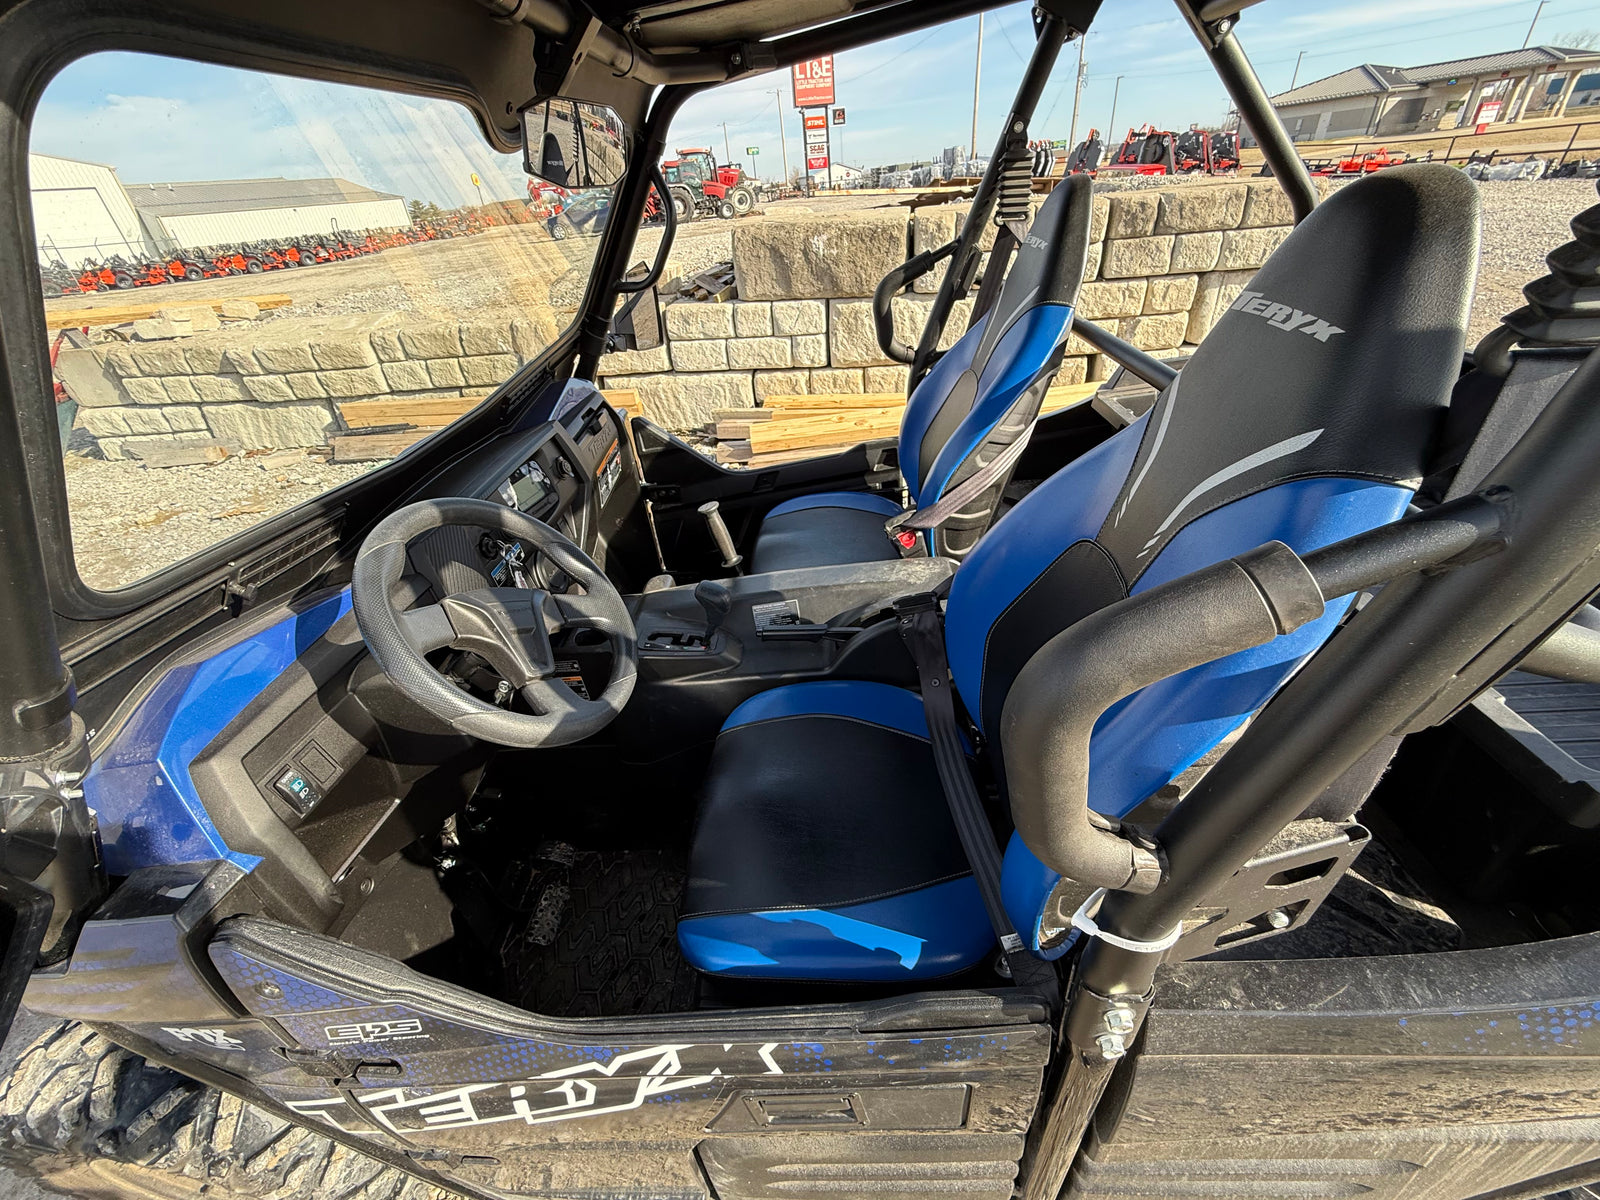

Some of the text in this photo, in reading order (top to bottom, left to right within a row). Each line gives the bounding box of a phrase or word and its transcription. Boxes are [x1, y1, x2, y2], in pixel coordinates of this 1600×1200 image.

[795, 57, 831, 79] LT&E
[1231, 291, 1346, 343] TERYX
[160, 1027, 246, 1052] FOX
[324, 1019, 422, 1041] EPS
